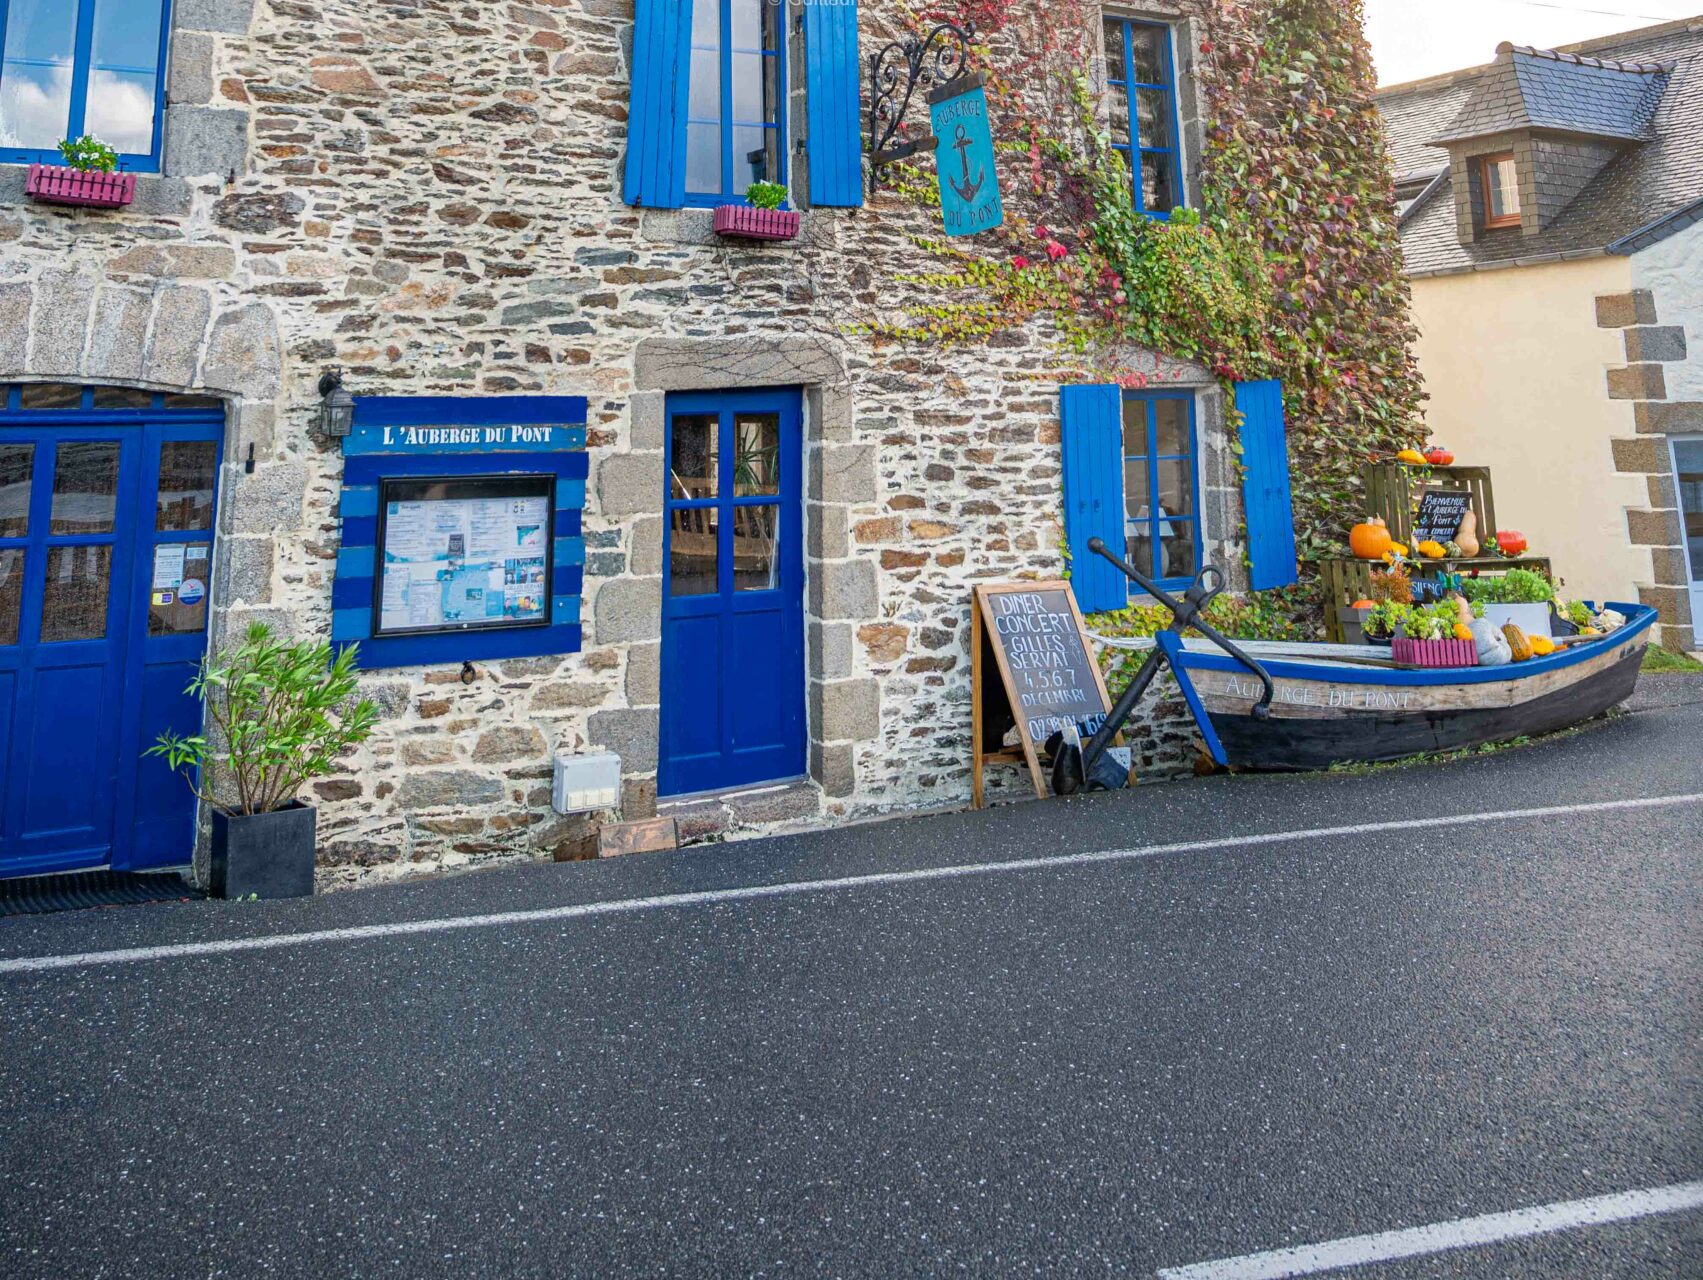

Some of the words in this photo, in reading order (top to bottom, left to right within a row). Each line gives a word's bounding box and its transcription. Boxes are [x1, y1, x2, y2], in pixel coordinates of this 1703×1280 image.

[949, 210, 962, 227] DU
[969, 196, 999, 225] PONT
[485, 427, 505, 443] DU
[511, 425, 552, 442] PONT
[1000, 594, 1048, 615] DINER
[995, 613, 1071, 635] CONCERT
[1011, 634, 1066, 653] GILLES
[1010, 651, 1069, 669] SERVAT
[1328, 690, 1355, 707] DU
[1364, 692, 1413, 709] PONT
